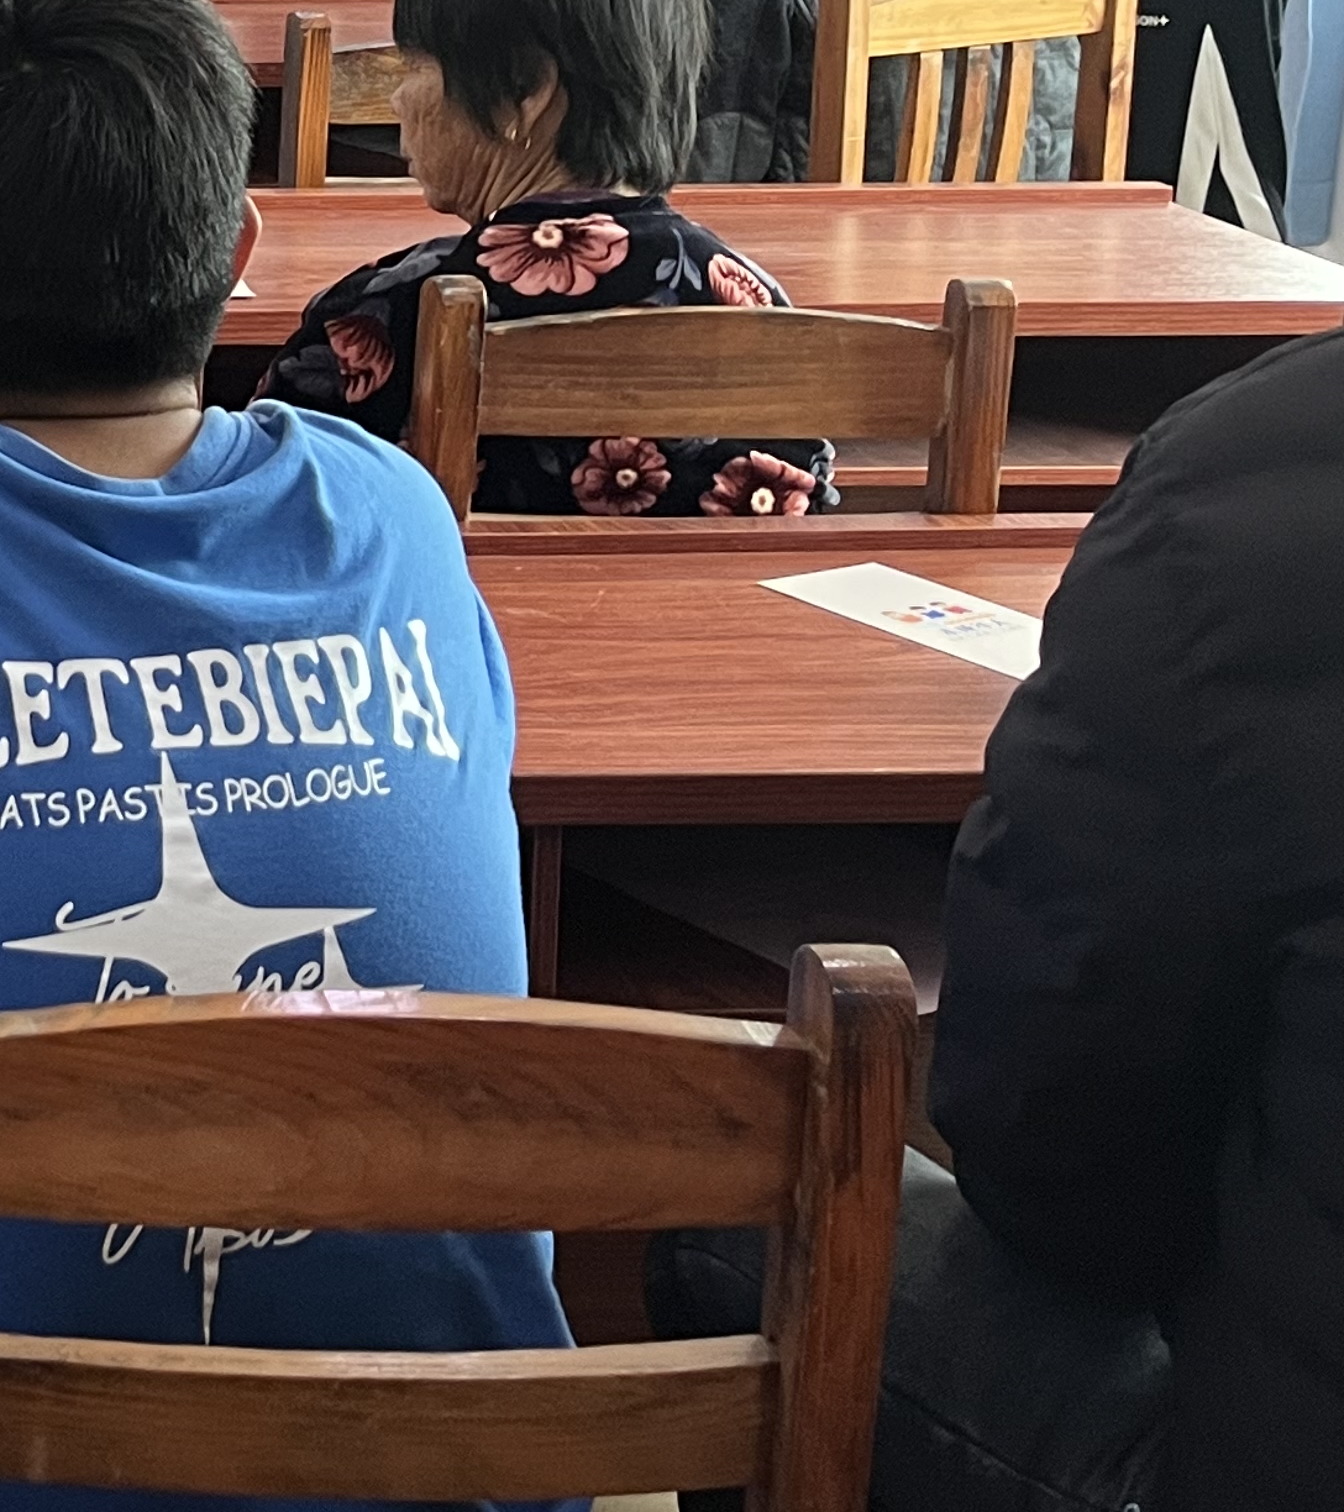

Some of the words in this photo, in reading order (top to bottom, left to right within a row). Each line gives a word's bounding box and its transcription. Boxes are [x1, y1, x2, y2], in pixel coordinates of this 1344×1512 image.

[76, 783, 172, 826] PAST
[182, 779, 218, 817] IS
[223, 757, 392, 815] PROLOGUE
